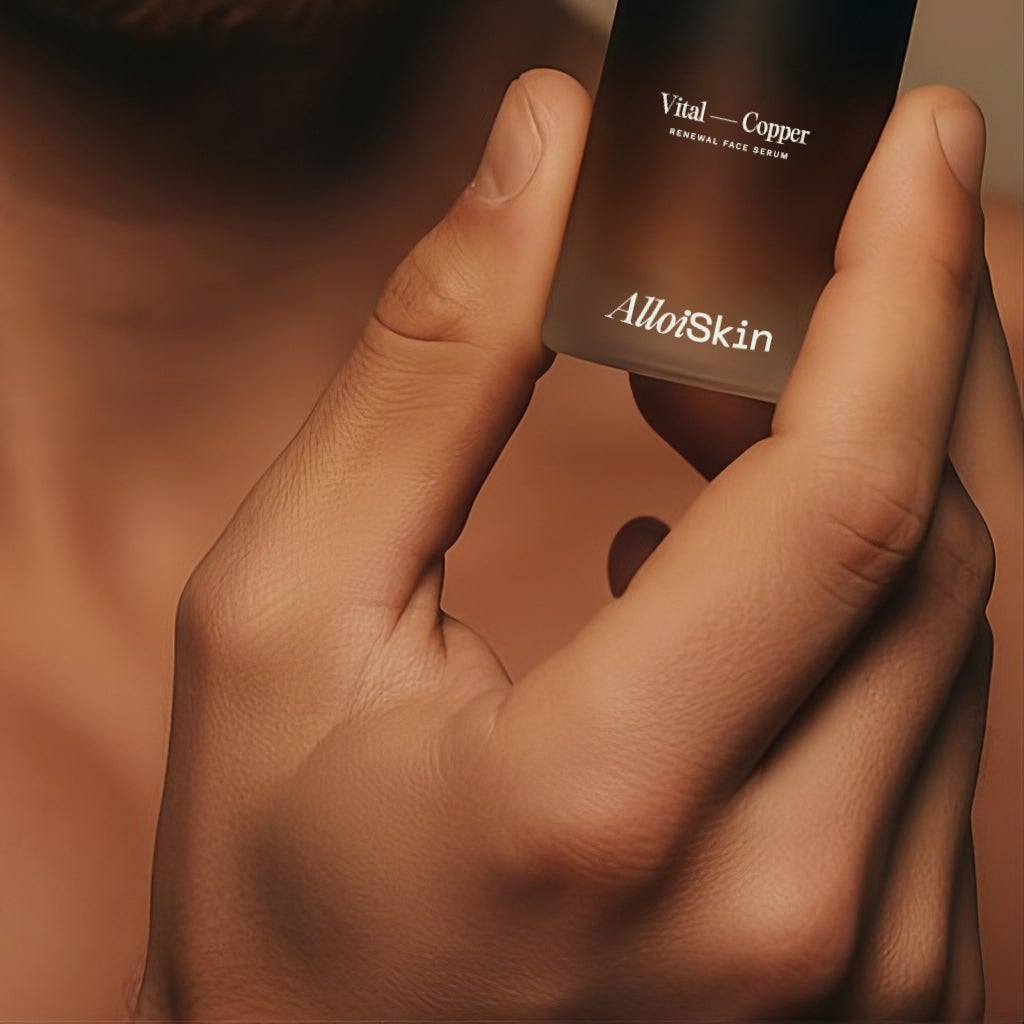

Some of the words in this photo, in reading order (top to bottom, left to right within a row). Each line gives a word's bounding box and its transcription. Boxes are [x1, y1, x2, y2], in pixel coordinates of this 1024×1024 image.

[661, 92, 708, 123] Vital
[742, 111, 811, 145] Copper
[669, 127, 718, 145] RENEWAL
[723, 139, 749, 152] FACE
[753, 146, 789, 160] SERUM
[604, 292, 773, 352] AlloiSkin
